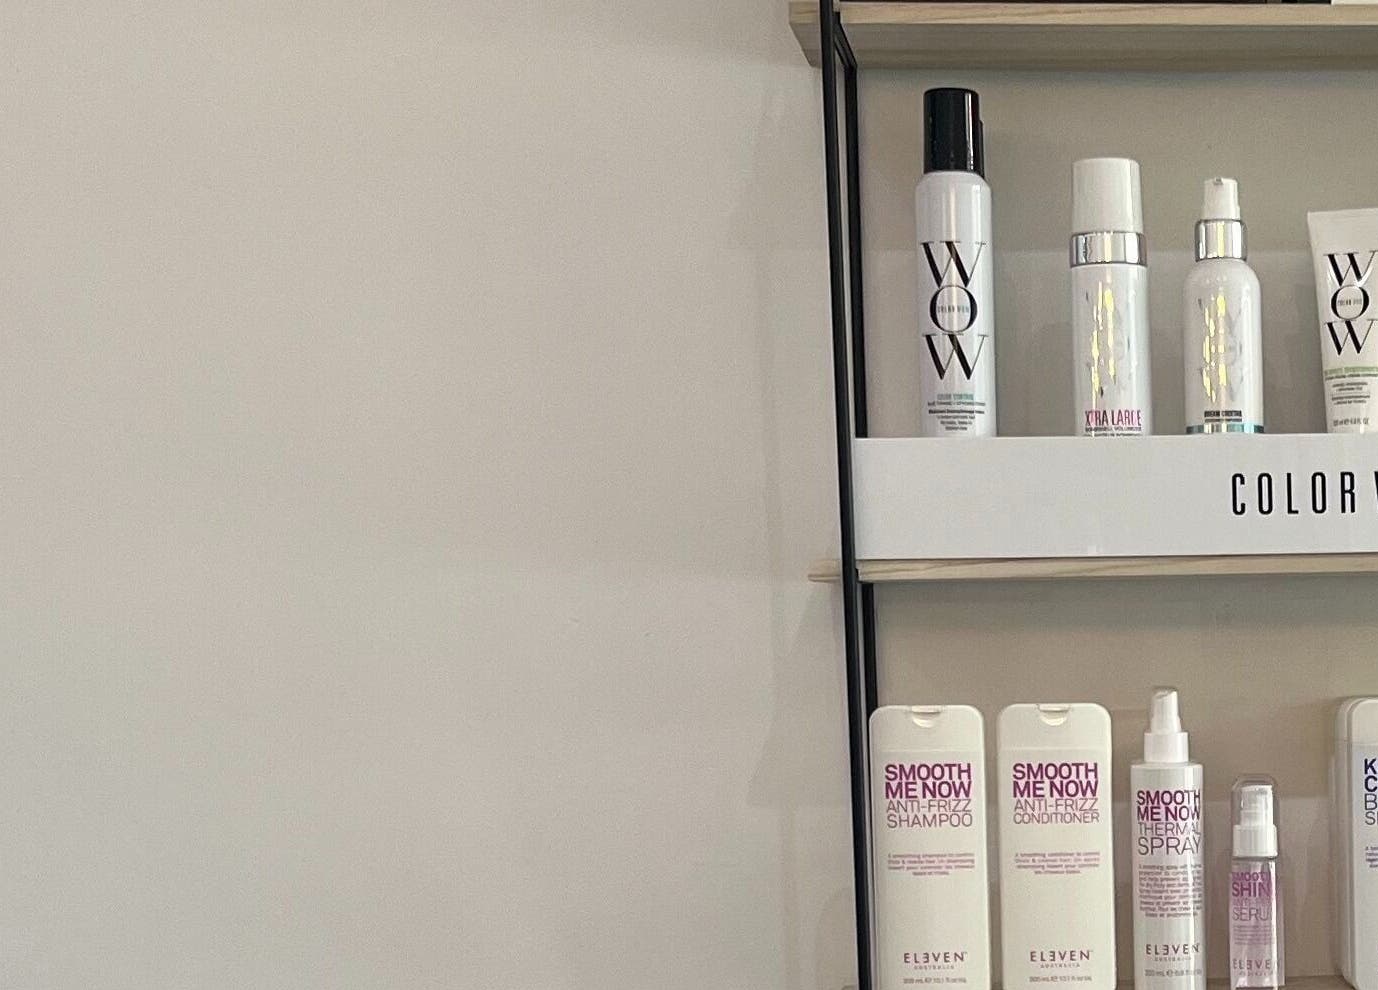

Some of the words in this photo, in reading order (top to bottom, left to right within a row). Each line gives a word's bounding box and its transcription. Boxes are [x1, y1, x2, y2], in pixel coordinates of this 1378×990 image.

[1231, 471, 1356, 516] COLOR
[884, 763, 972, 781] SMOOTH
[1012, 762, 1098, 780] SMOOTH
[885, 781, 918, 799] ME
[922, 781, 972, 799] NOW
[1012, 780, 1045, 798] ME
[1049, 780, 1098, 798] NOW
[1013, 798, 1099, 812] ANTI-FRIZZ
[1136, 789, 1201, 806] SMOOTH
[886, 799, 972, 814] ANTI-FRIZZ
[1136, 806, 1161, 822] ME
[1165, 805, 1201, 822] NOW
[886, 813, 973, 829] SHAMPOO
[1013, 812, 1100, 825] CONDITIONER
[1138, 822, 1202, 837] THERMAL
[1137, 836, 1201, 856] SPRAY
[1232, 881, 1272, 898] SHIN
[1232, 907, 1272, 921] SERU
[1030, 951, 1090, 962] ELEVEN
[1146, 943, 1200, 956] ELEVEN
[903, 952, 965, 964] ELEVEN
[1233, 959, 1272, 970] ELEVE
